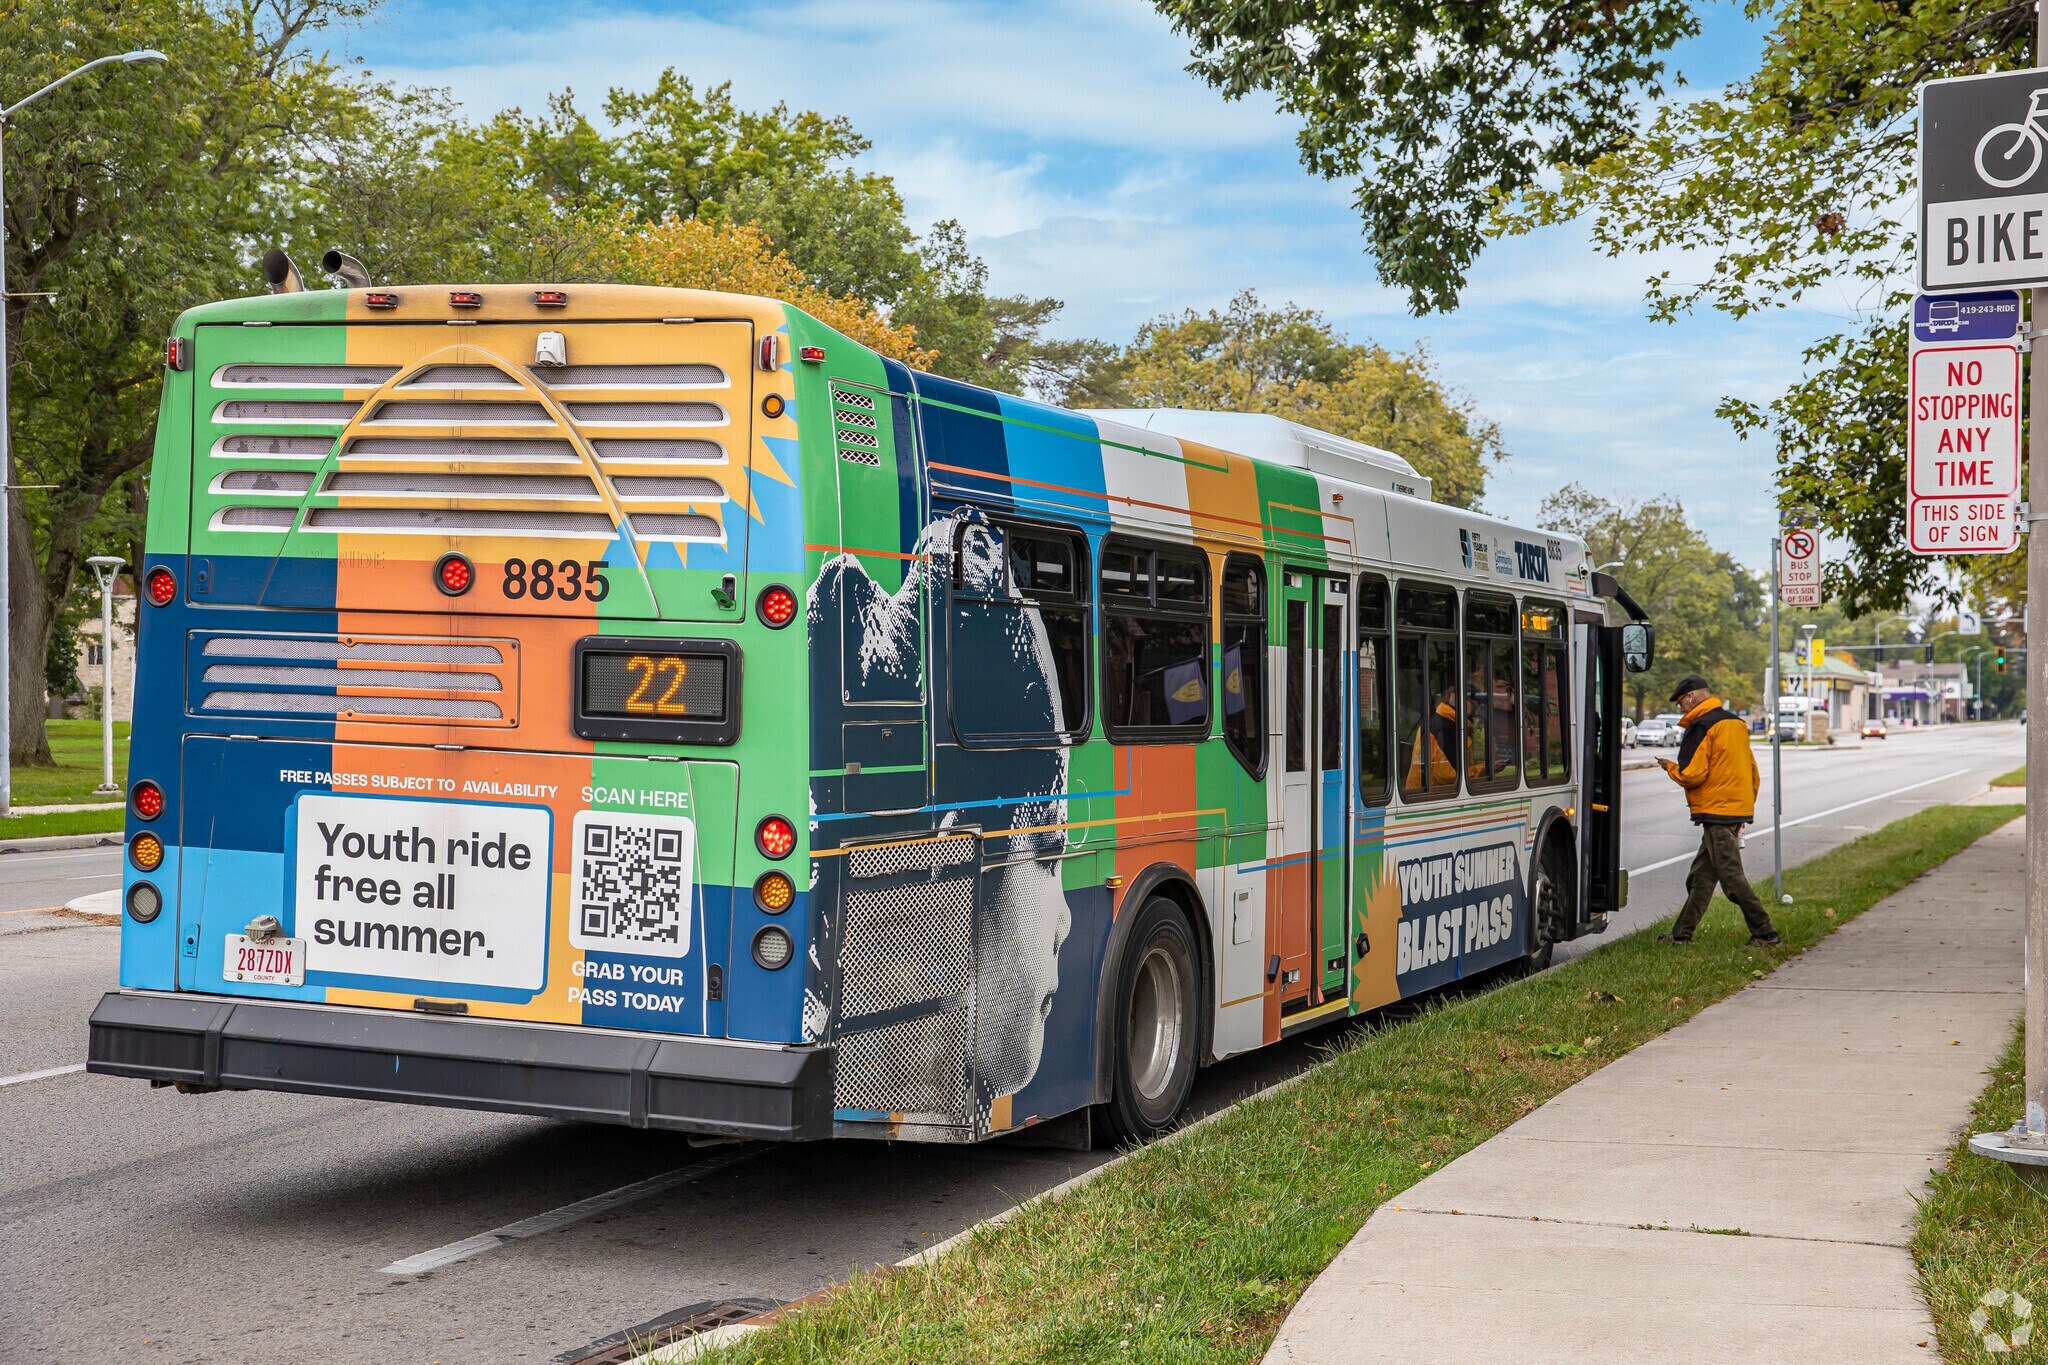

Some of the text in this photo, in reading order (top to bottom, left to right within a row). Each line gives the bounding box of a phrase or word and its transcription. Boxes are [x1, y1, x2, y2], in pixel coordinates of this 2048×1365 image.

[1947, 210, 2043, 266] BIKE
[1960, 304, 2016, 314] 419-243-RIDE
[1948, 361, 1983, 386] NO
[1918, 393, 2012, 421] STOPPING
[1937, 427, 1991, 453] ANY
[1935, 461, 1993, 486] TIME
[1922, 504, 2005, 521] THIS SIDE
[1929, 525, 1998, 542] OF SIGN
[1788, 572, 1812, 581] STOP
[1791, 561, 1809, 570] BUS
[503, 558, 610, 602] 8835
[626, 656, 687, 712] 22
[280, 769, 558, 799] FREE PASSES SUBJECT TO AVAILABILITY
[581, 785, 689, 809] SCAN HERE
[317, 822, 531, 870] Youth ride
[315, 864, 456, 910] free all
[1398, 845, 1515, 906] YOUTH SUMMER
[314, 918, 494, 959] summer.
[1397, 893, 1513, 976] BLAST PASS
[238, 948, 292, 974] 287ZDX
[571, 961, 683, 986] GRAB YOUR
[567, 987, 685, 1013] PASS TODAY
